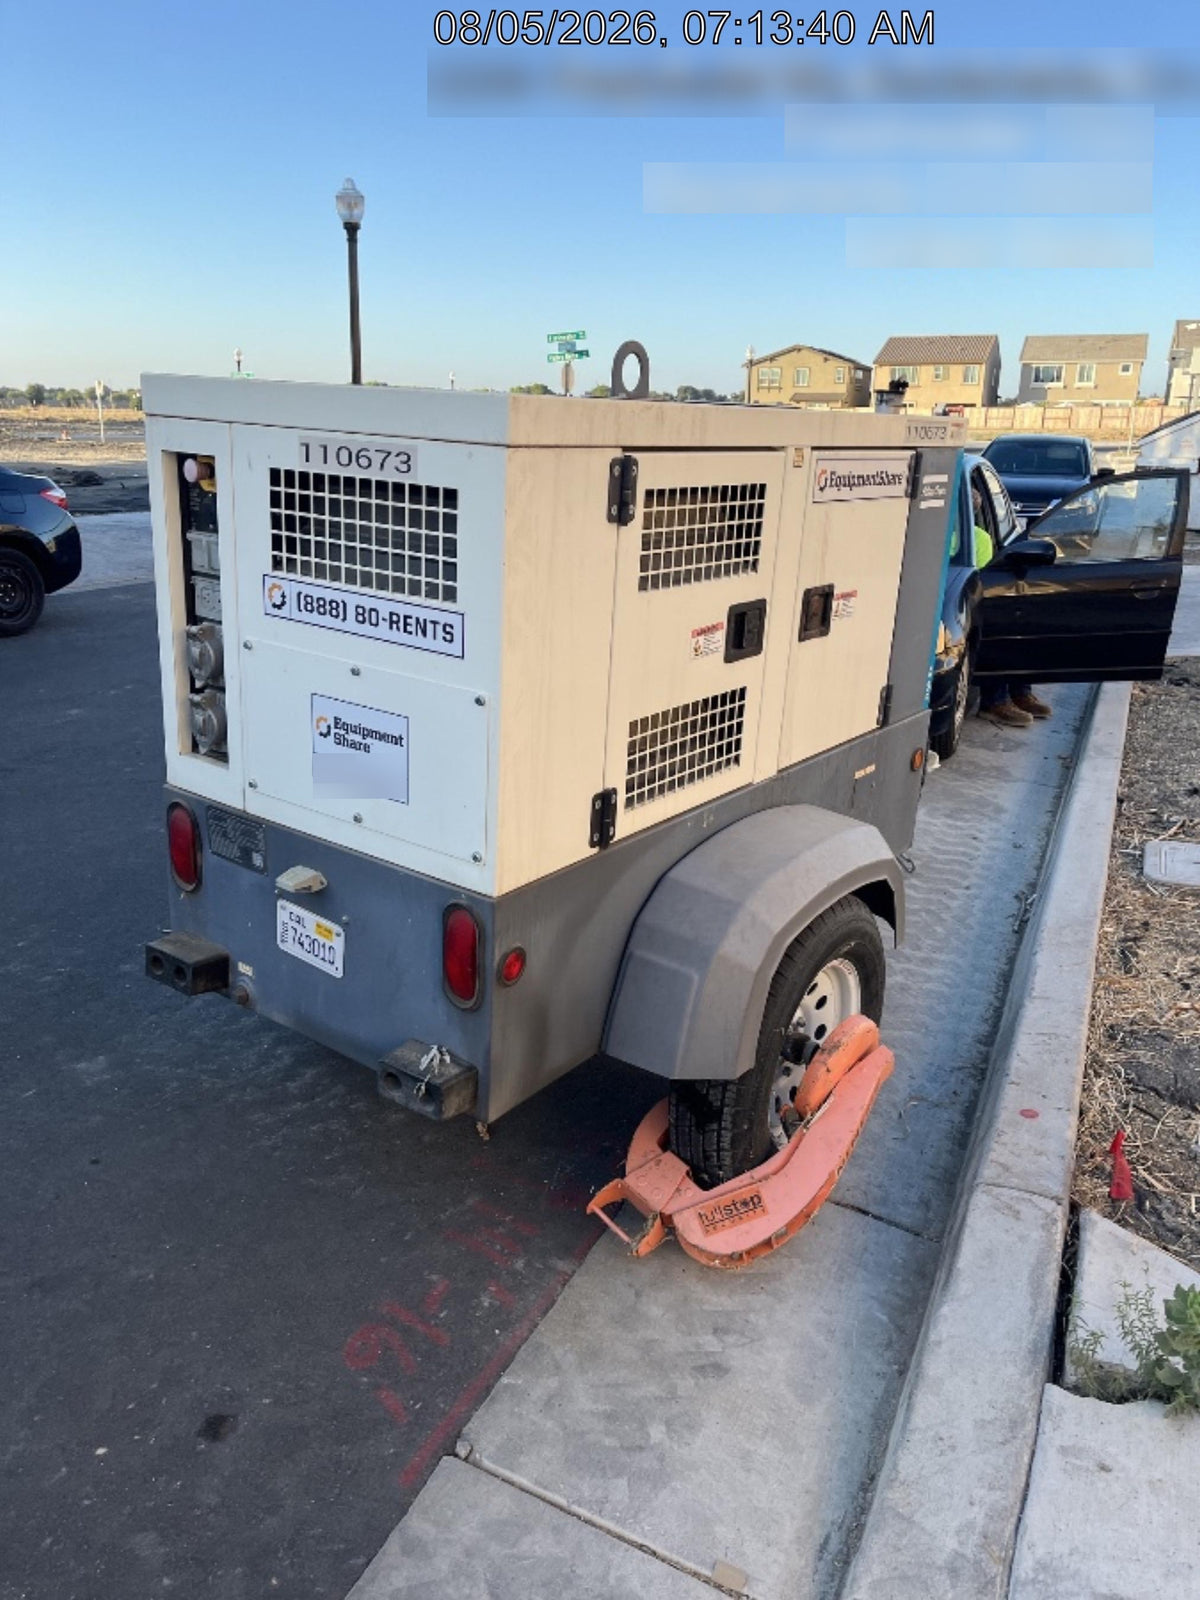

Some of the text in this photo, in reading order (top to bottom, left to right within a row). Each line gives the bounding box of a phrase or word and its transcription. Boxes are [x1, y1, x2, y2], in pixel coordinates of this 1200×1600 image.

[300, 442, 413, 475] 110673
[296, 591, 455, 644] (888) 80-RENTS
[333, 716, 405, 748] Equipment
[333, 732, 371, 754] Share
